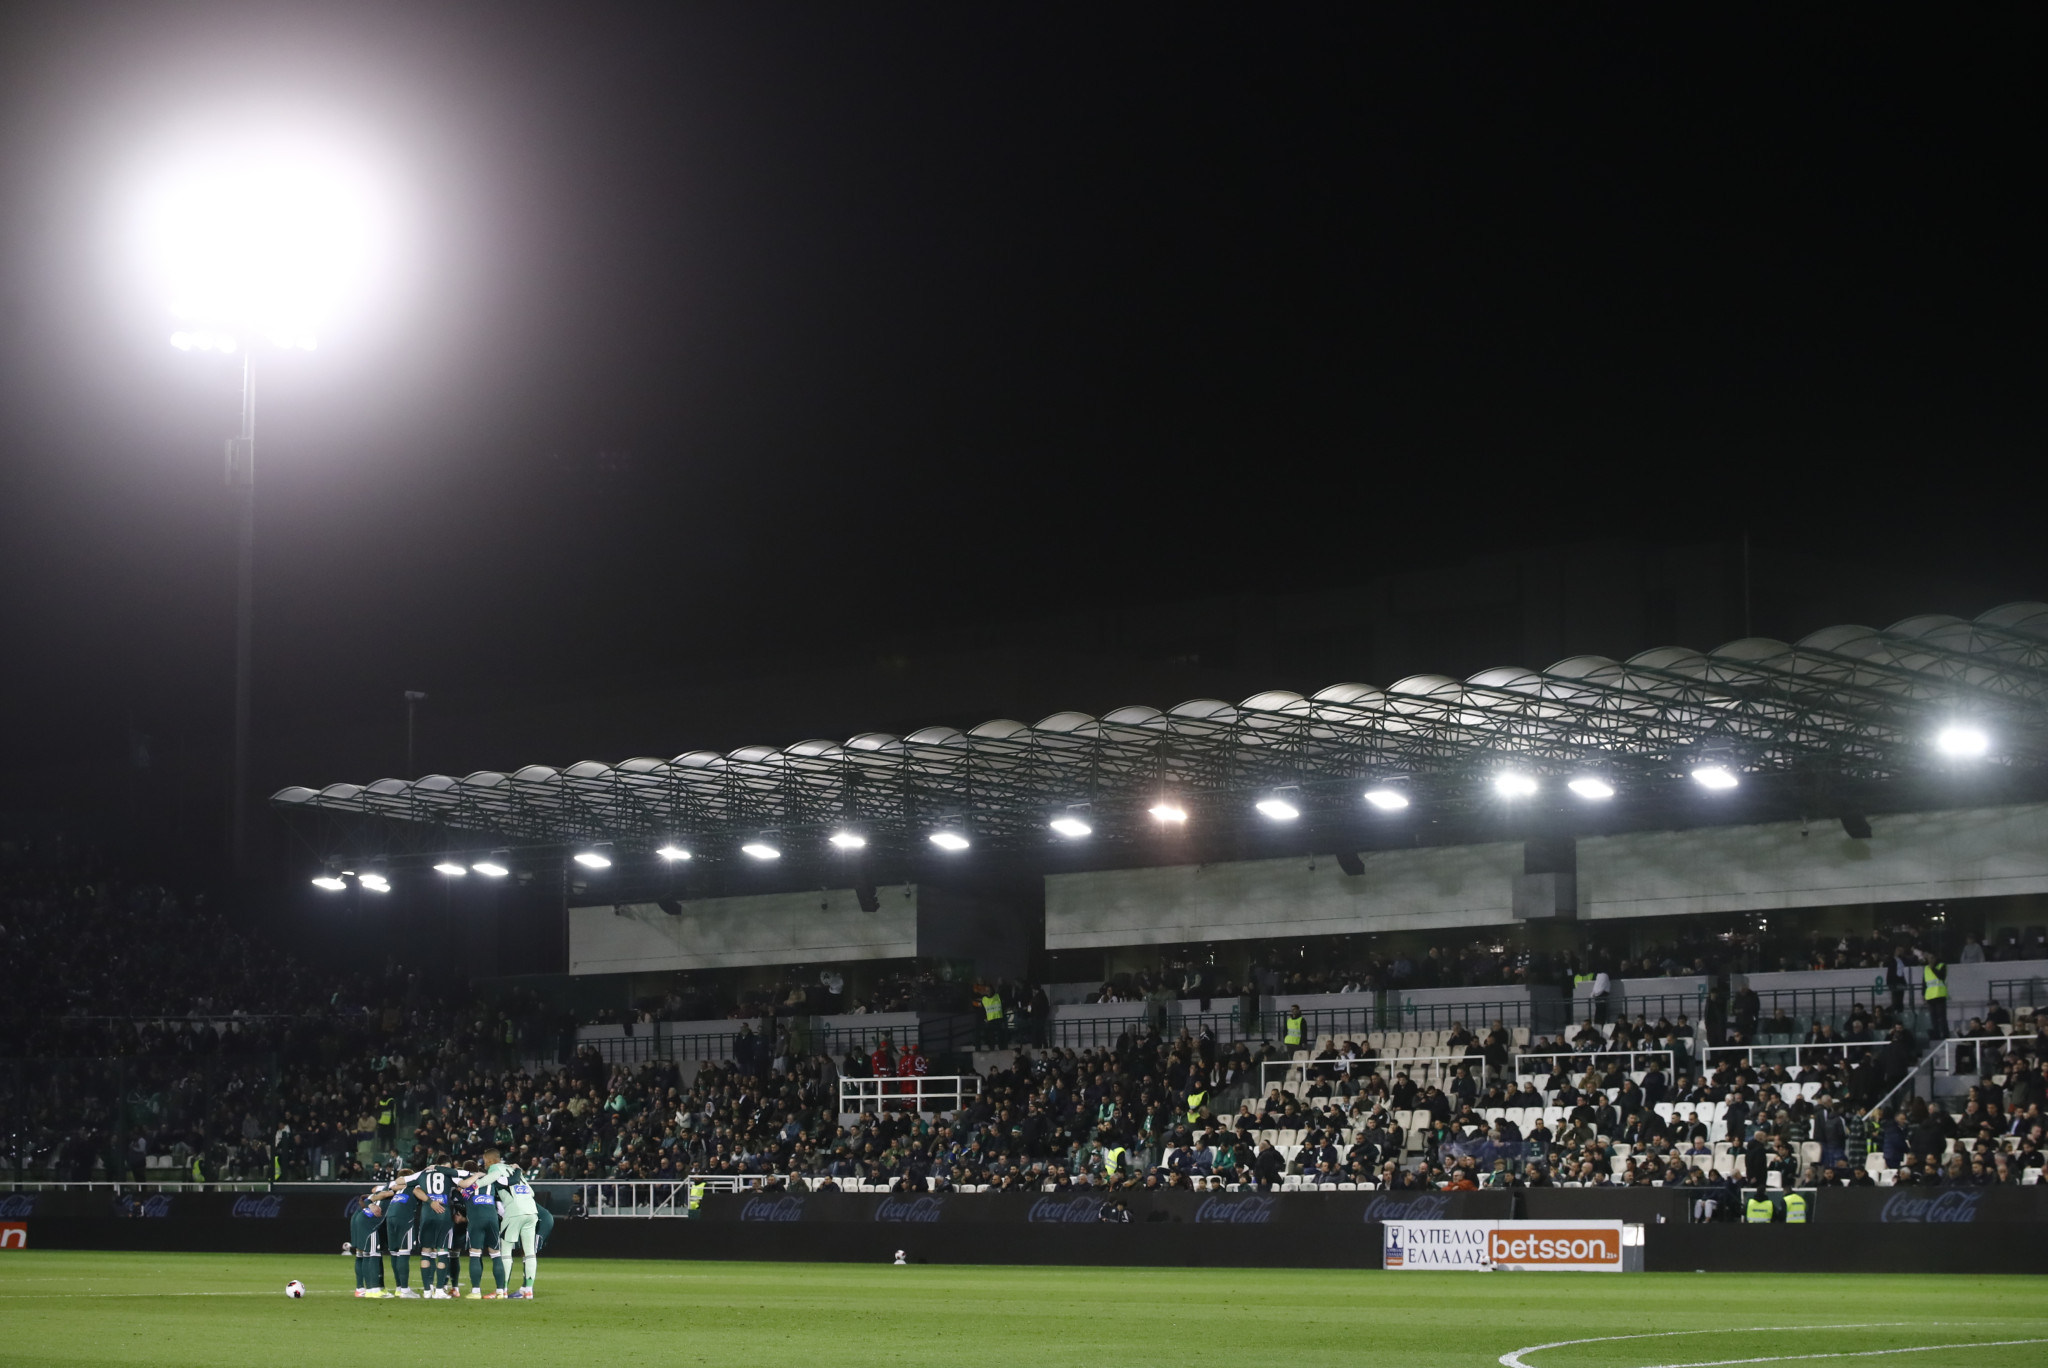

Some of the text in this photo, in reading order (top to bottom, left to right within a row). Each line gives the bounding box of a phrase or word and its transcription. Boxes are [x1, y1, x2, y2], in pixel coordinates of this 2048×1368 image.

[1875, 976, 1883, 995] 8
[426, 1172, 445, 1195] 18
[1195, 1196, 1277, 1222] Coca-Cola
[1408, 1228, 1485, 1245] ΚΥΠΕΛΛΟ
[1492, 1233, 1606, 1260] betsson
[1408, 1248, 1484, 1264] ΕΛΛΑΔΑΣ
